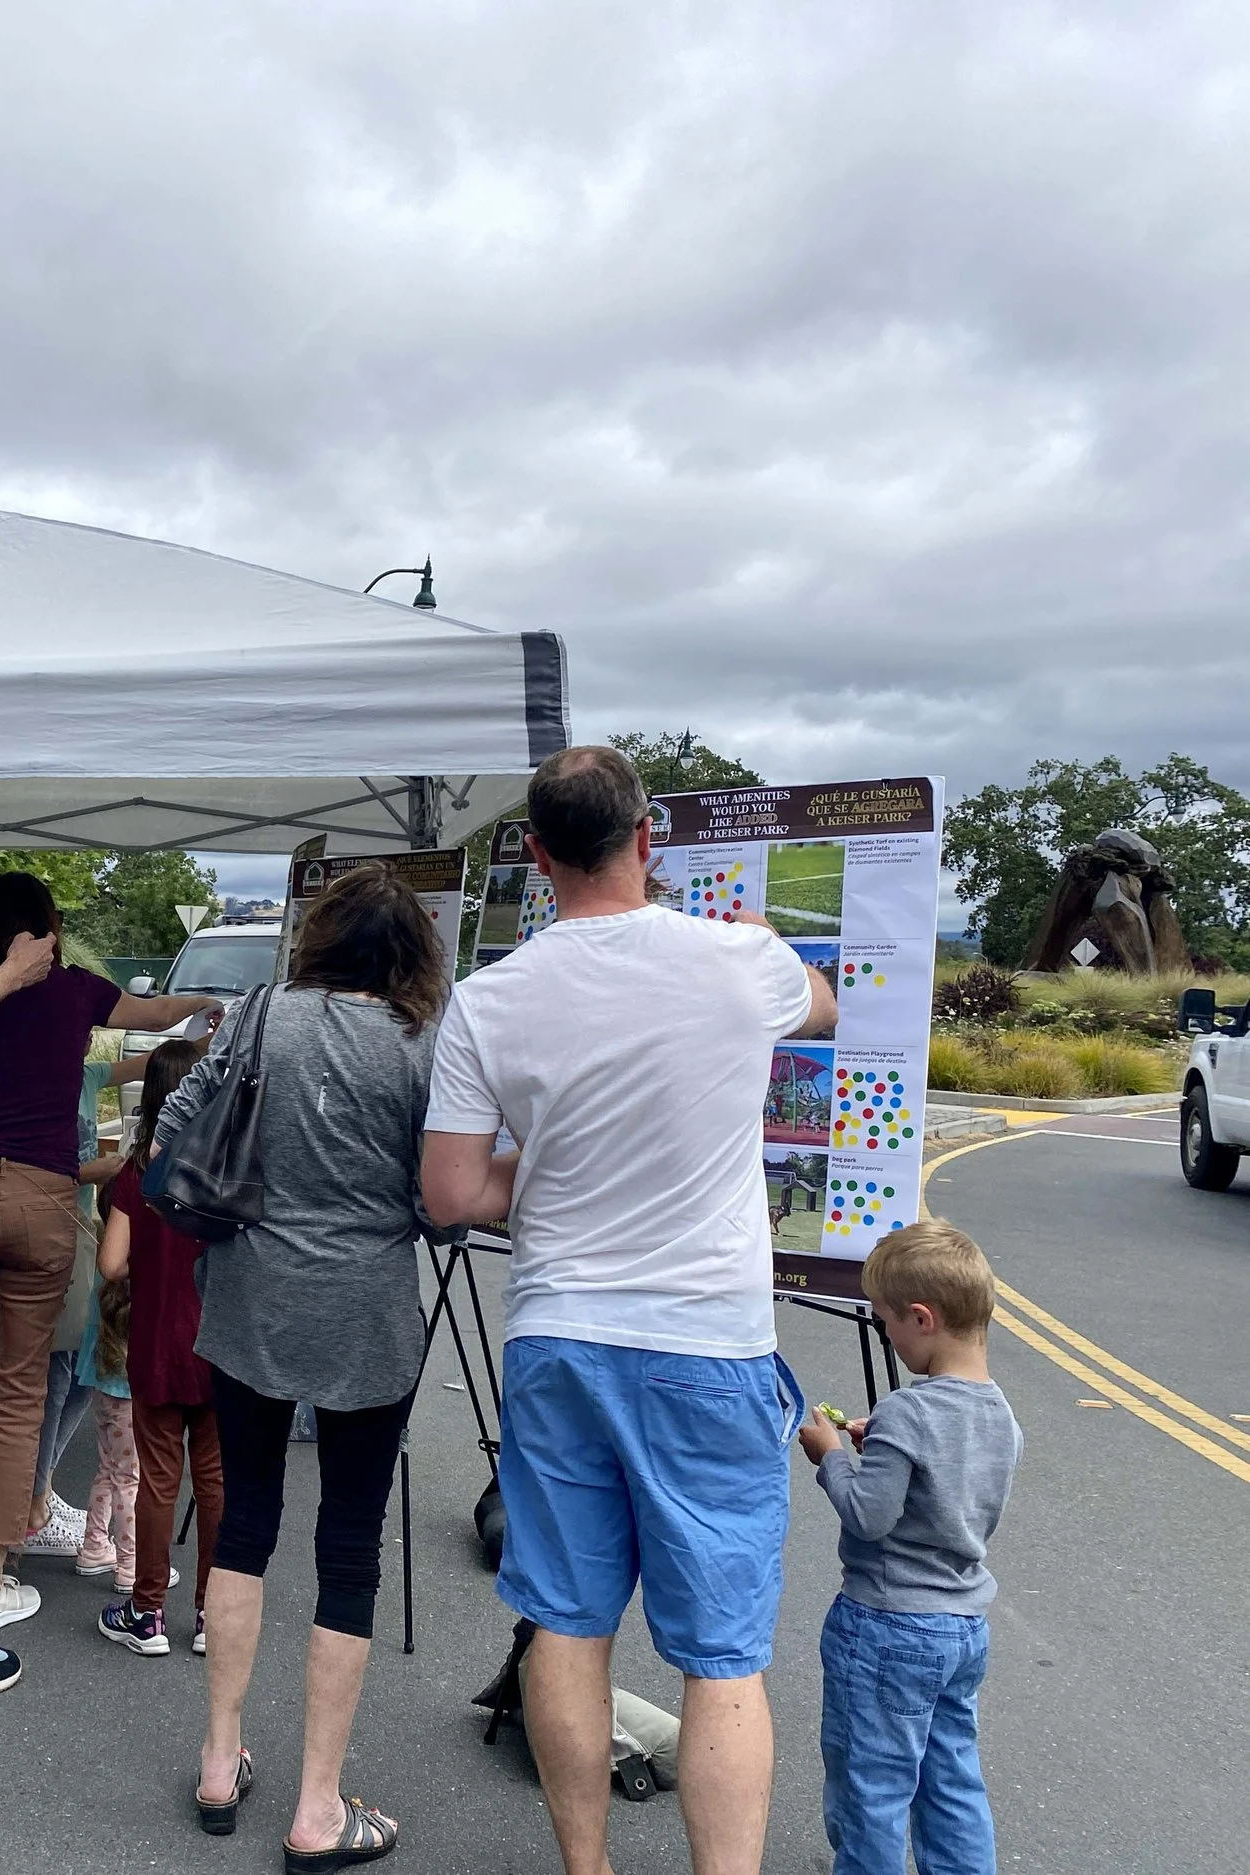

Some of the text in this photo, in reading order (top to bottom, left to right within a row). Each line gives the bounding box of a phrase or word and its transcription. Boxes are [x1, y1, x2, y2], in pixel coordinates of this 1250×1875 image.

[700, 791, 790, 806] WHAT AMENITIES
[811, 787, 920, 806] ¿QUÉ LE GUSTARÍA
[712, 803, 776, 816] WOULD YOU
[807, 799, 924, 816] QUE SE AGREGARA
[710, 815, 777, 827] LIKE ADDED
[816, 812, 911, 826] A KEISER PARK?
[698, 825, 789, 839] TO KEISER PARK?
